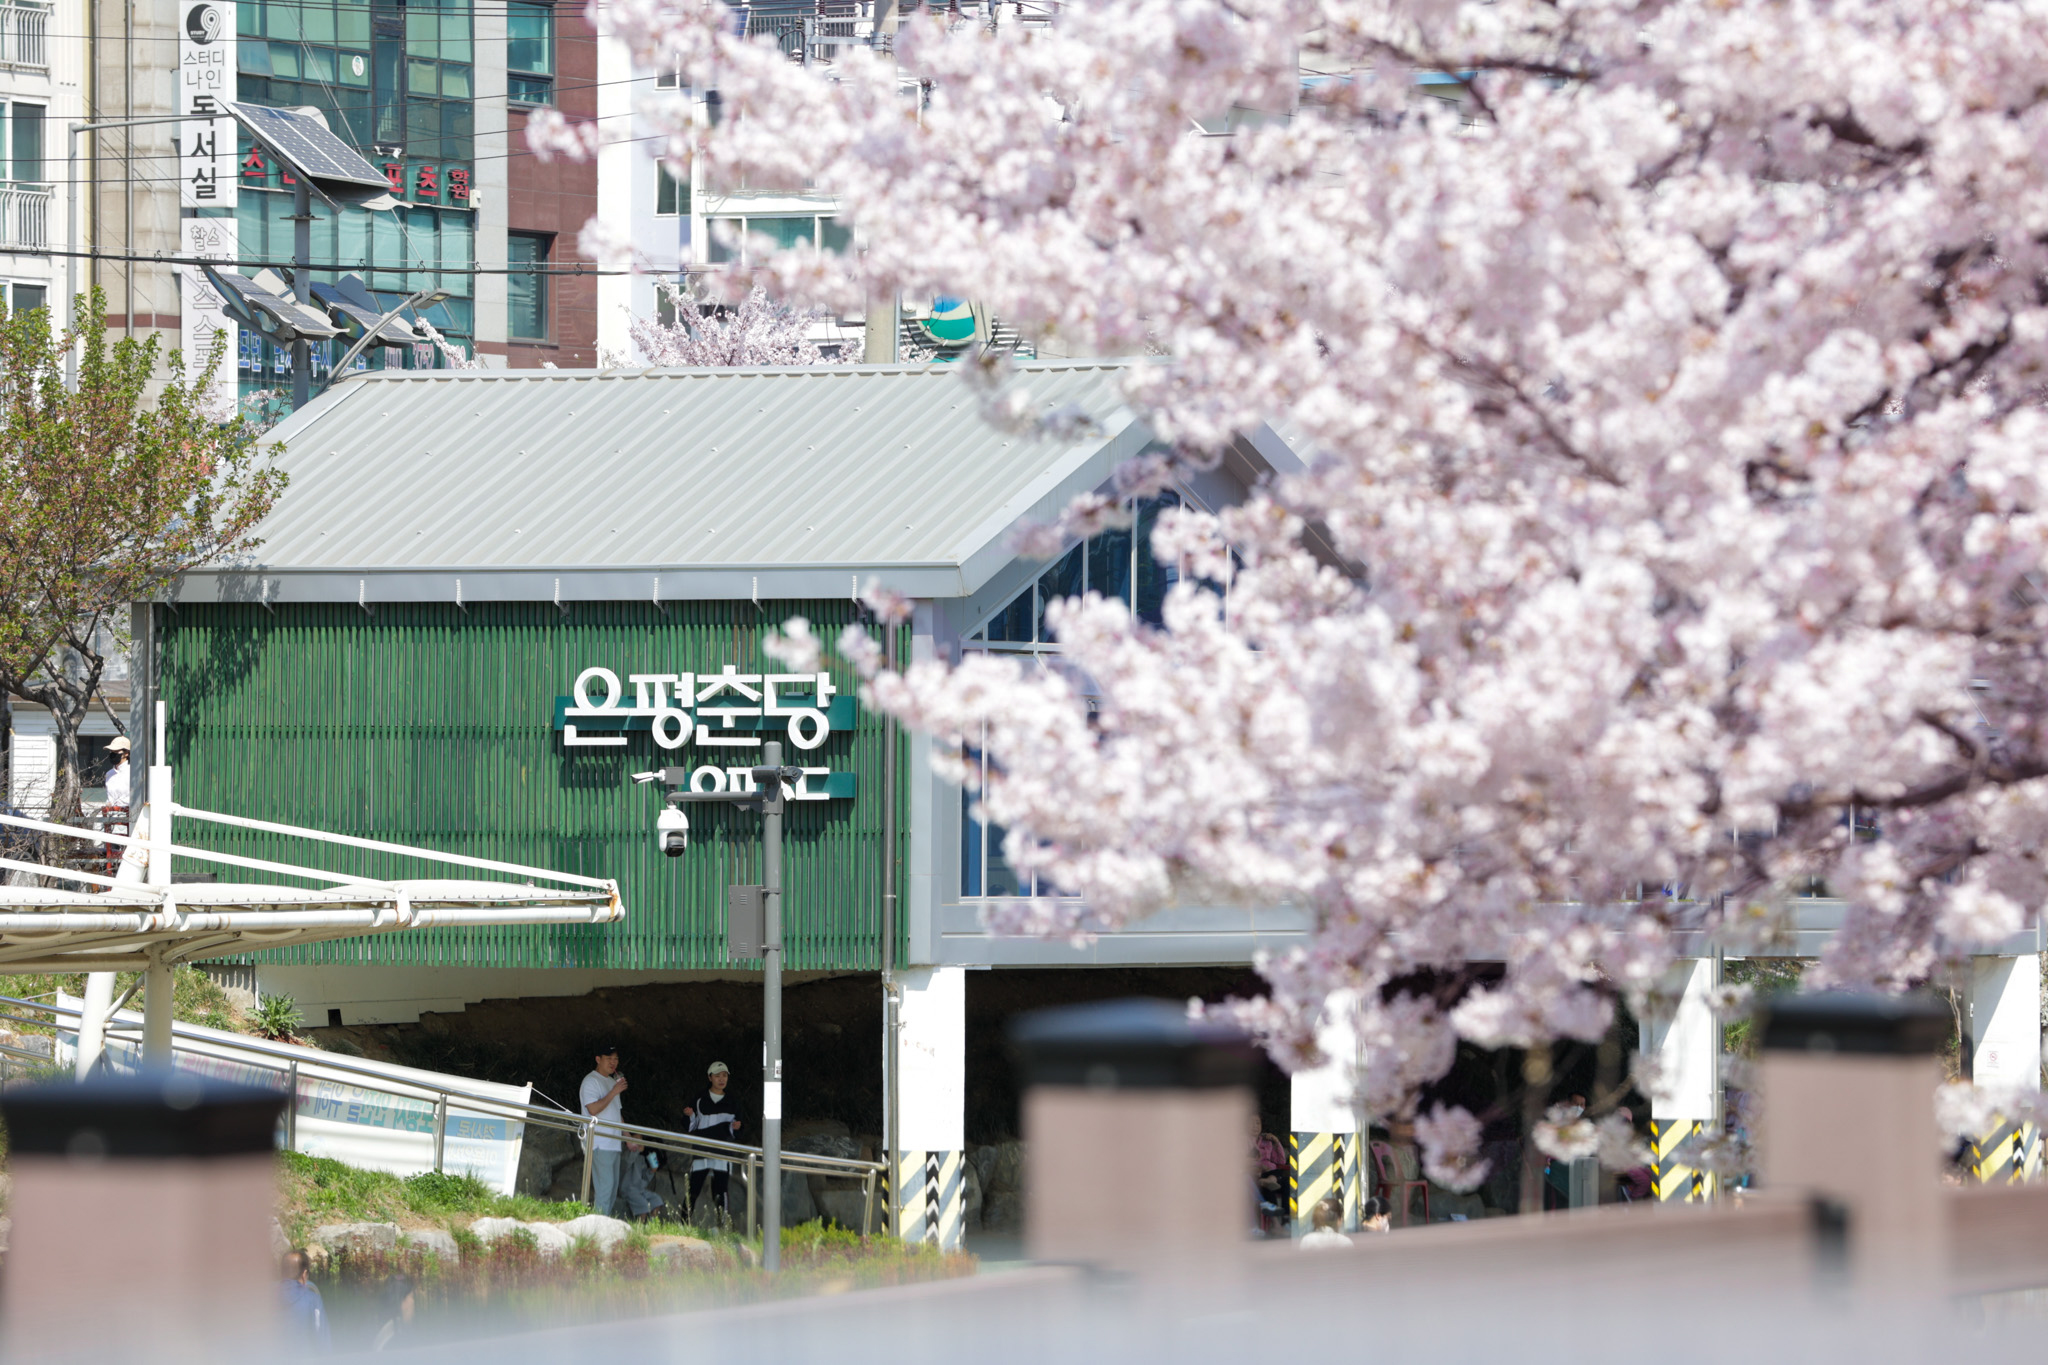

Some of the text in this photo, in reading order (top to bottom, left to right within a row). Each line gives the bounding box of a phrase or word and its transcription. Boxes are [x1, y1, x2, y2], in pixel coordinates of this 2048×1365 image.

[183, 49, 225, 67] 스터디
[186, 69, 221, 90] 나인
[190, 95, 217, 200] 독서실
[191, 225, 220, 252] 찰스
[564, 665, 837, 750] 은평춘당
